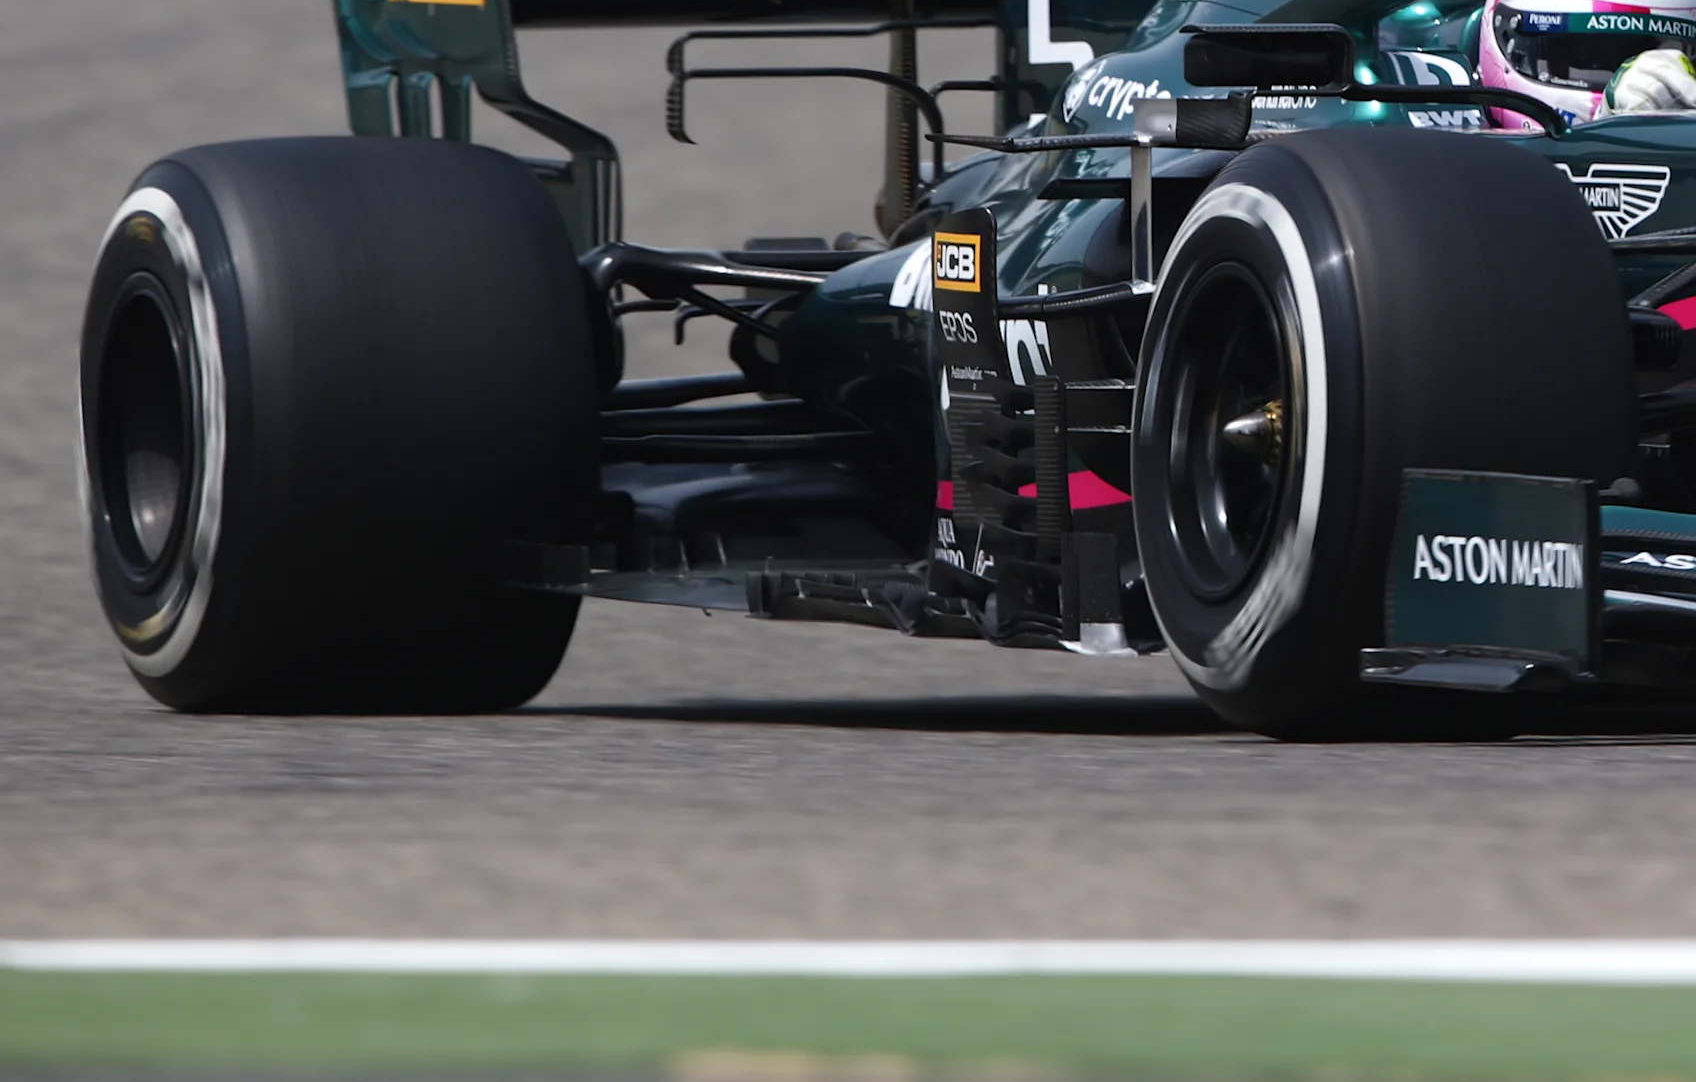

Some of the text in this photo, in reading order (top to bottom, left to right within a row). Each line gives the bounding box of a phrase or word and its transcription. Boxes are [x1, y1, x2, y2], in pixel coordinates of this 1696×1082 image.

[1587, 16, 1644, 31] ASTON
[1408, 109, 1482, 128] BWT
[937, 245, 976, 281] JCB
[939, 310, 978, 344] EPOS
[1413, 534, 1584, 589] ASTON MARTIN
